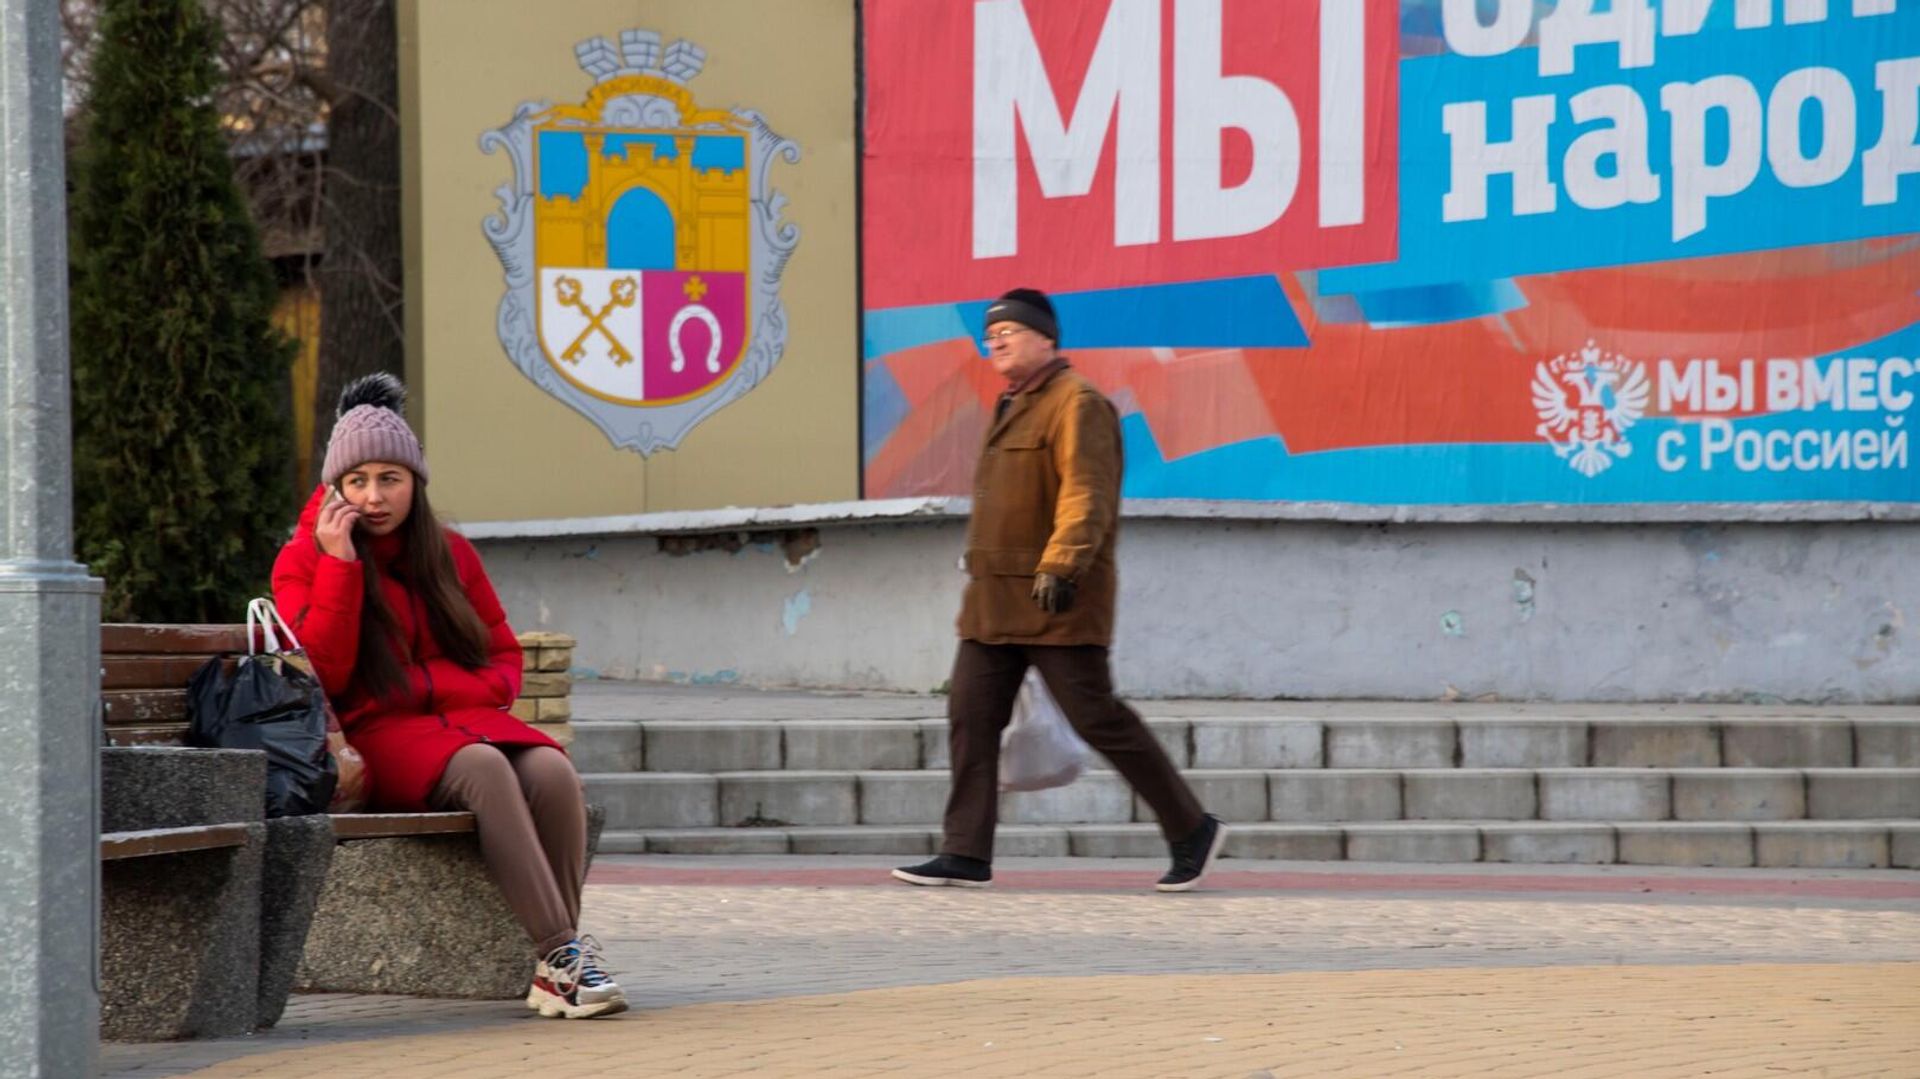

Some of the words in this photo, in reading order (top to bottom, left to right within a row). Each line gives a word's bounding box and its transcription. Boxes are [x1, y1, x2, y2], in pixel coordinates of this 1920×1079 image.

[1442, 0, 1896, 77] од
[972, 0, 1365, 259] МЫ
[1658, 359, 1755, 412] МЫ
[1767, 357, 1920, 412] ВМЕС
[1657, 430, 1686, 471] с
[1700, 415, 1908, 471] Россией
